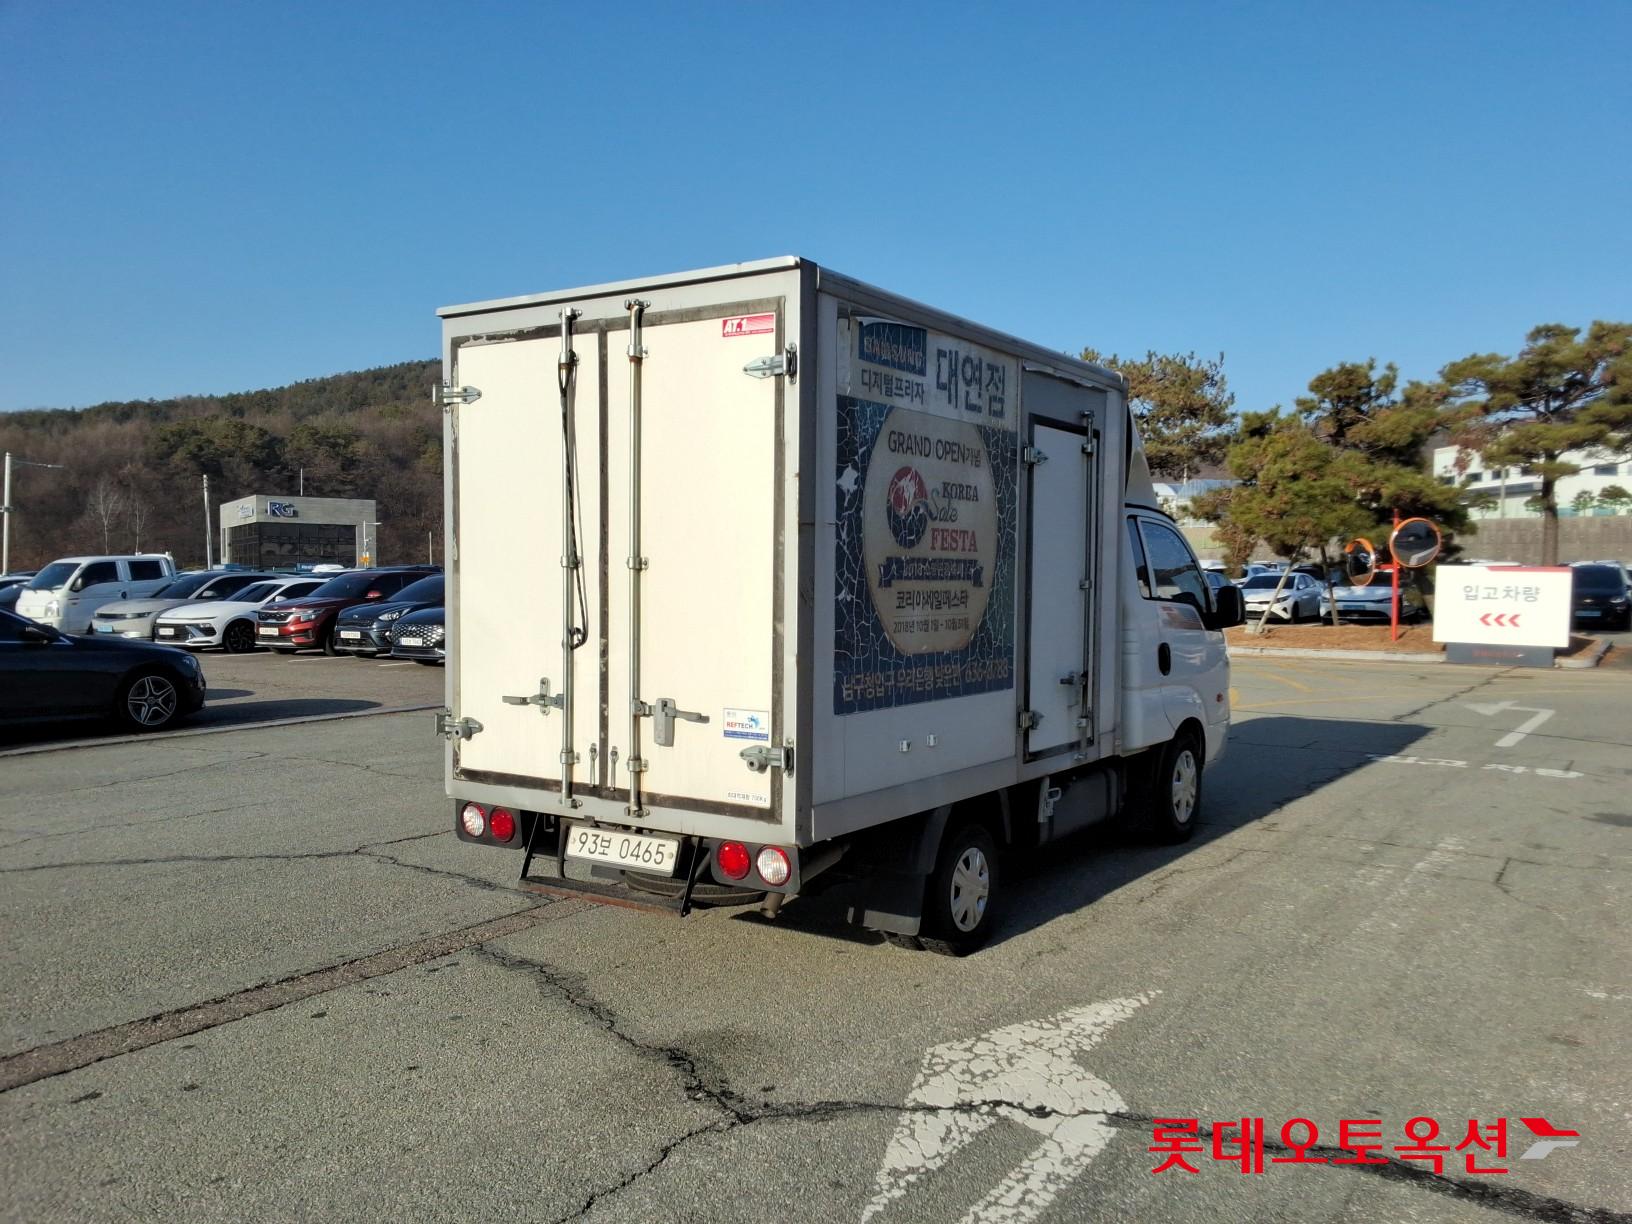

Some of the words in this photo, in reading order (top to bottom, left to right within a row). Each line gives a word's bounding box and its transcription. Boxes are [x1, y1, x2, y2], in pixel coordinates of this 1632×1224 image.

[936, 349, 1005, 419] 대연점
[888, 430, 932, 458] GRAND
[928, 487, 959, 522] Sale
[942, 482, 979, 502] KOREA
[930, 527, 978, 552] FESTA
[896, 589, 969, 610] 코리아세일페스타
[1463, 585, 1541, 603] 입고차량
[578, 832, 612, 856] 93보
[619, 838, 666, 865] 0465
